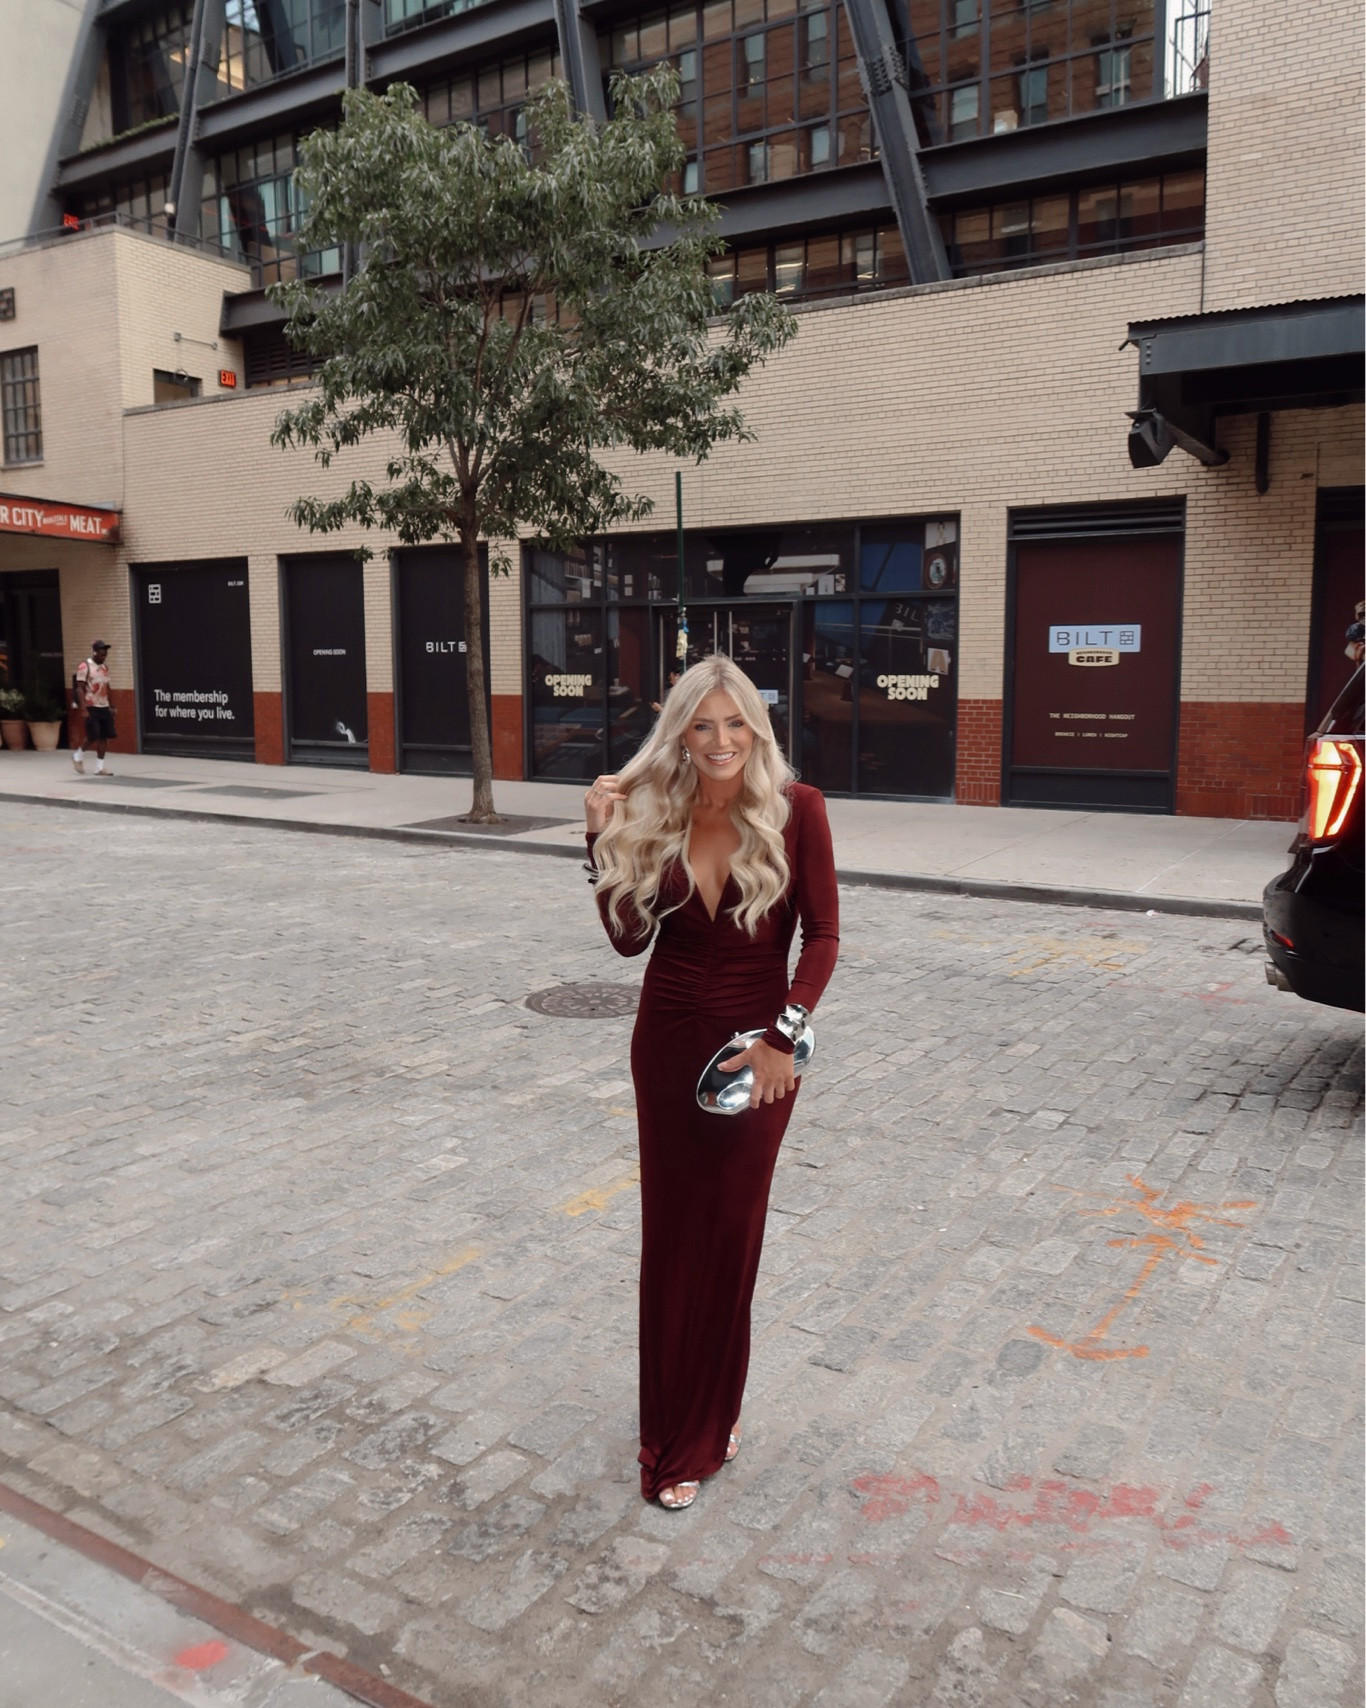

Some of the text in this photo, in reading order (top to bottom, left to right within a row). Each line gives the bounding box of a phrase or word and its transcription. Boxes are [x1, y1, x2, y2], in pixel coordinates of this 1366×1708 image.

[221, 370, 235, 386] EXIT
[12, 507, 44, 528] CITY
[69, 514, 102, 534] MEAT
[1056, 631, 1113, 646] BILT
[425, 641, 456, 653] BILT
[1075, 655, 1113, 663] CAFE
[545, 674, 593, 686] OPENING
[876, 674, 939, 688] OPENING
[154, 689, 229, 706] The membership
[553, 685, 584, 697] SOON
[887, 687, 928, 701] SOON
[155, 704, 235, 722] for where you live.
